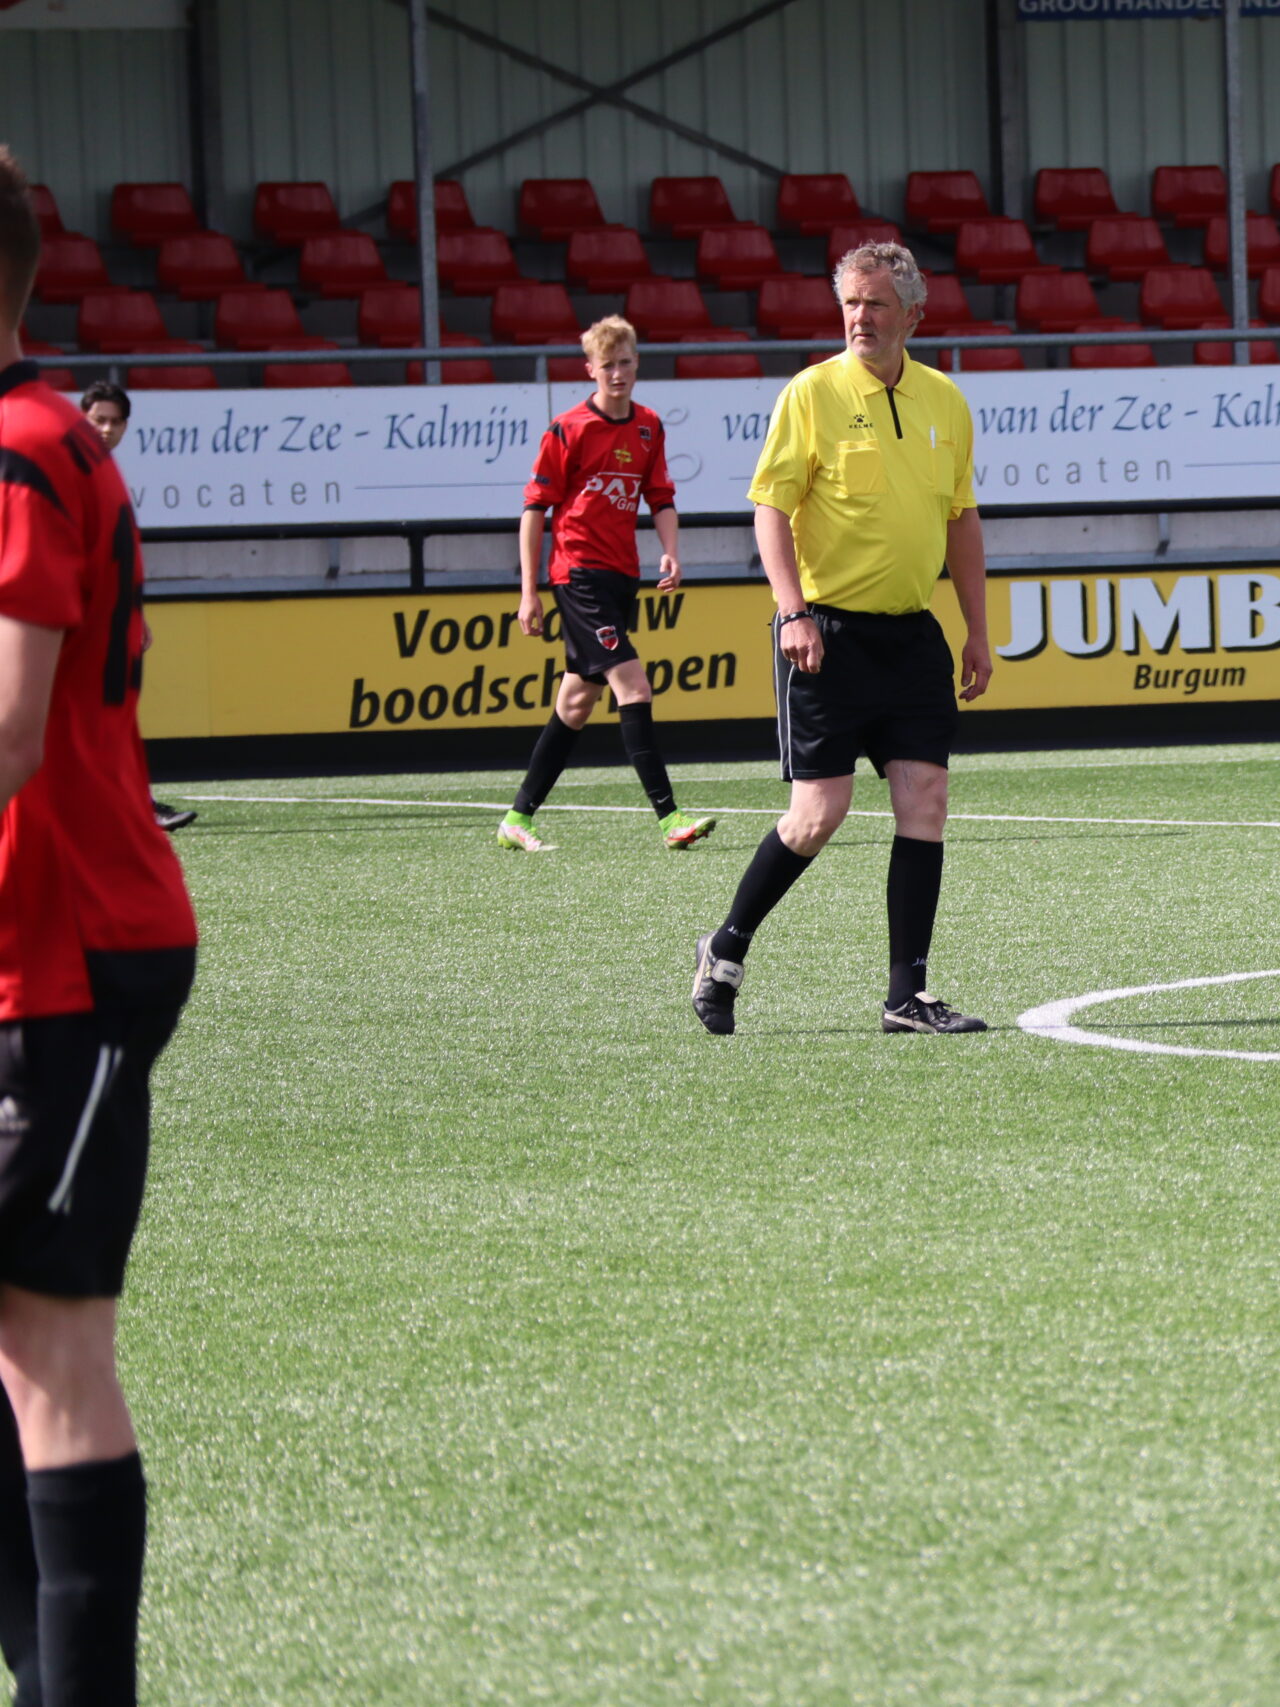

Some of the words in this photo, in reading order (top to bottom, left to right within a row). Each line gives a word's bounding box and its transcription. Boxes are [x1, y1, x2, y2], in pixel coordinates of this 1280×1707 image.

[136, 426, 199, 456] van
[211, 408, 268, 454] der
[279, 416, 342, 453] Zee
[384, 403, 528, 463] Kalmijn
[978, 406, 1038, 435] van
[1049, 389, 1103, 433] der
[1112, 395, 1172, 431] Zee
[393, 609, 520, 659] Voor
[1133, 663, 1246, 695] Burgum
